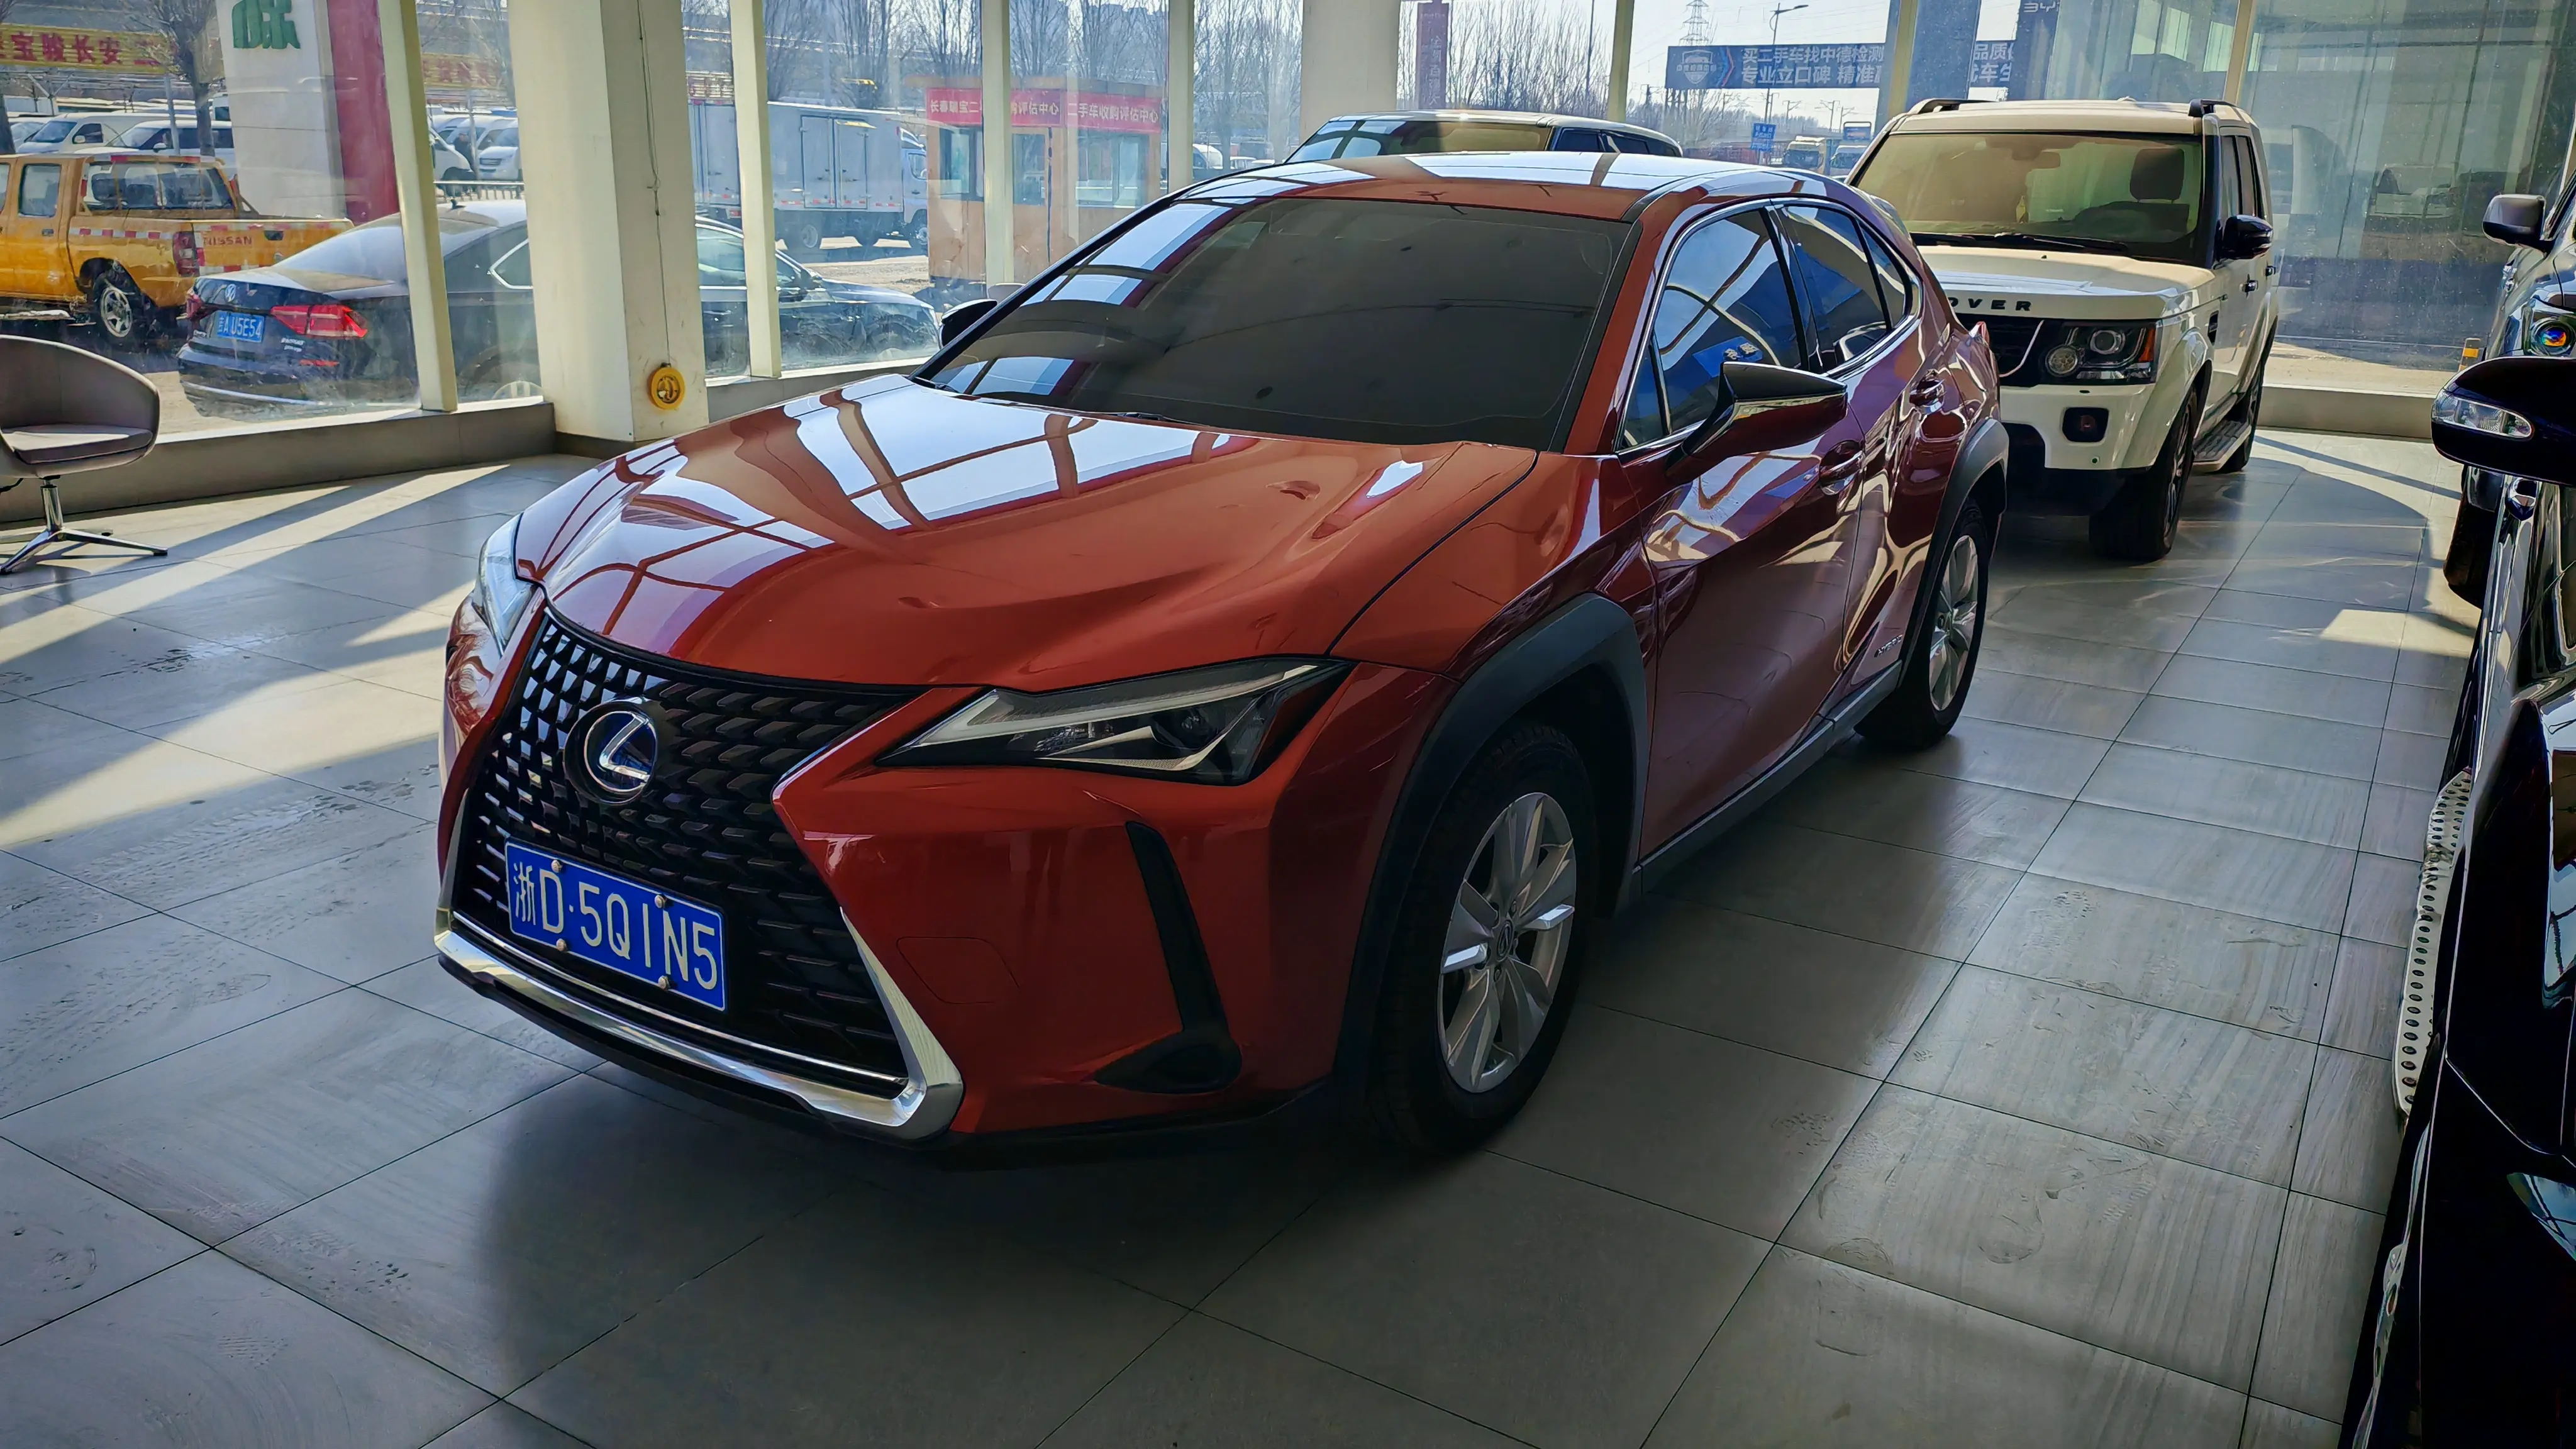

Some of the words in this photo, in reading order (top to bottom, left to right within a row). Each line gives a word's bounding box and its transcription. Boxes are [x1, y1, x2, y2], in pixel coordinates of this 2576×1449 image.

[2023, 2, 2060, 13] BY
[1742, 46, 1884, 64] 买二手车找中德检测
[1741, 65, 1831, 84] 专业立口碑
[1836, 65, 1882, 84] 精准
[1067, 103, 1159, 123] 二手车收购评估中心
[203, 235, 253, 247] NISSAN
